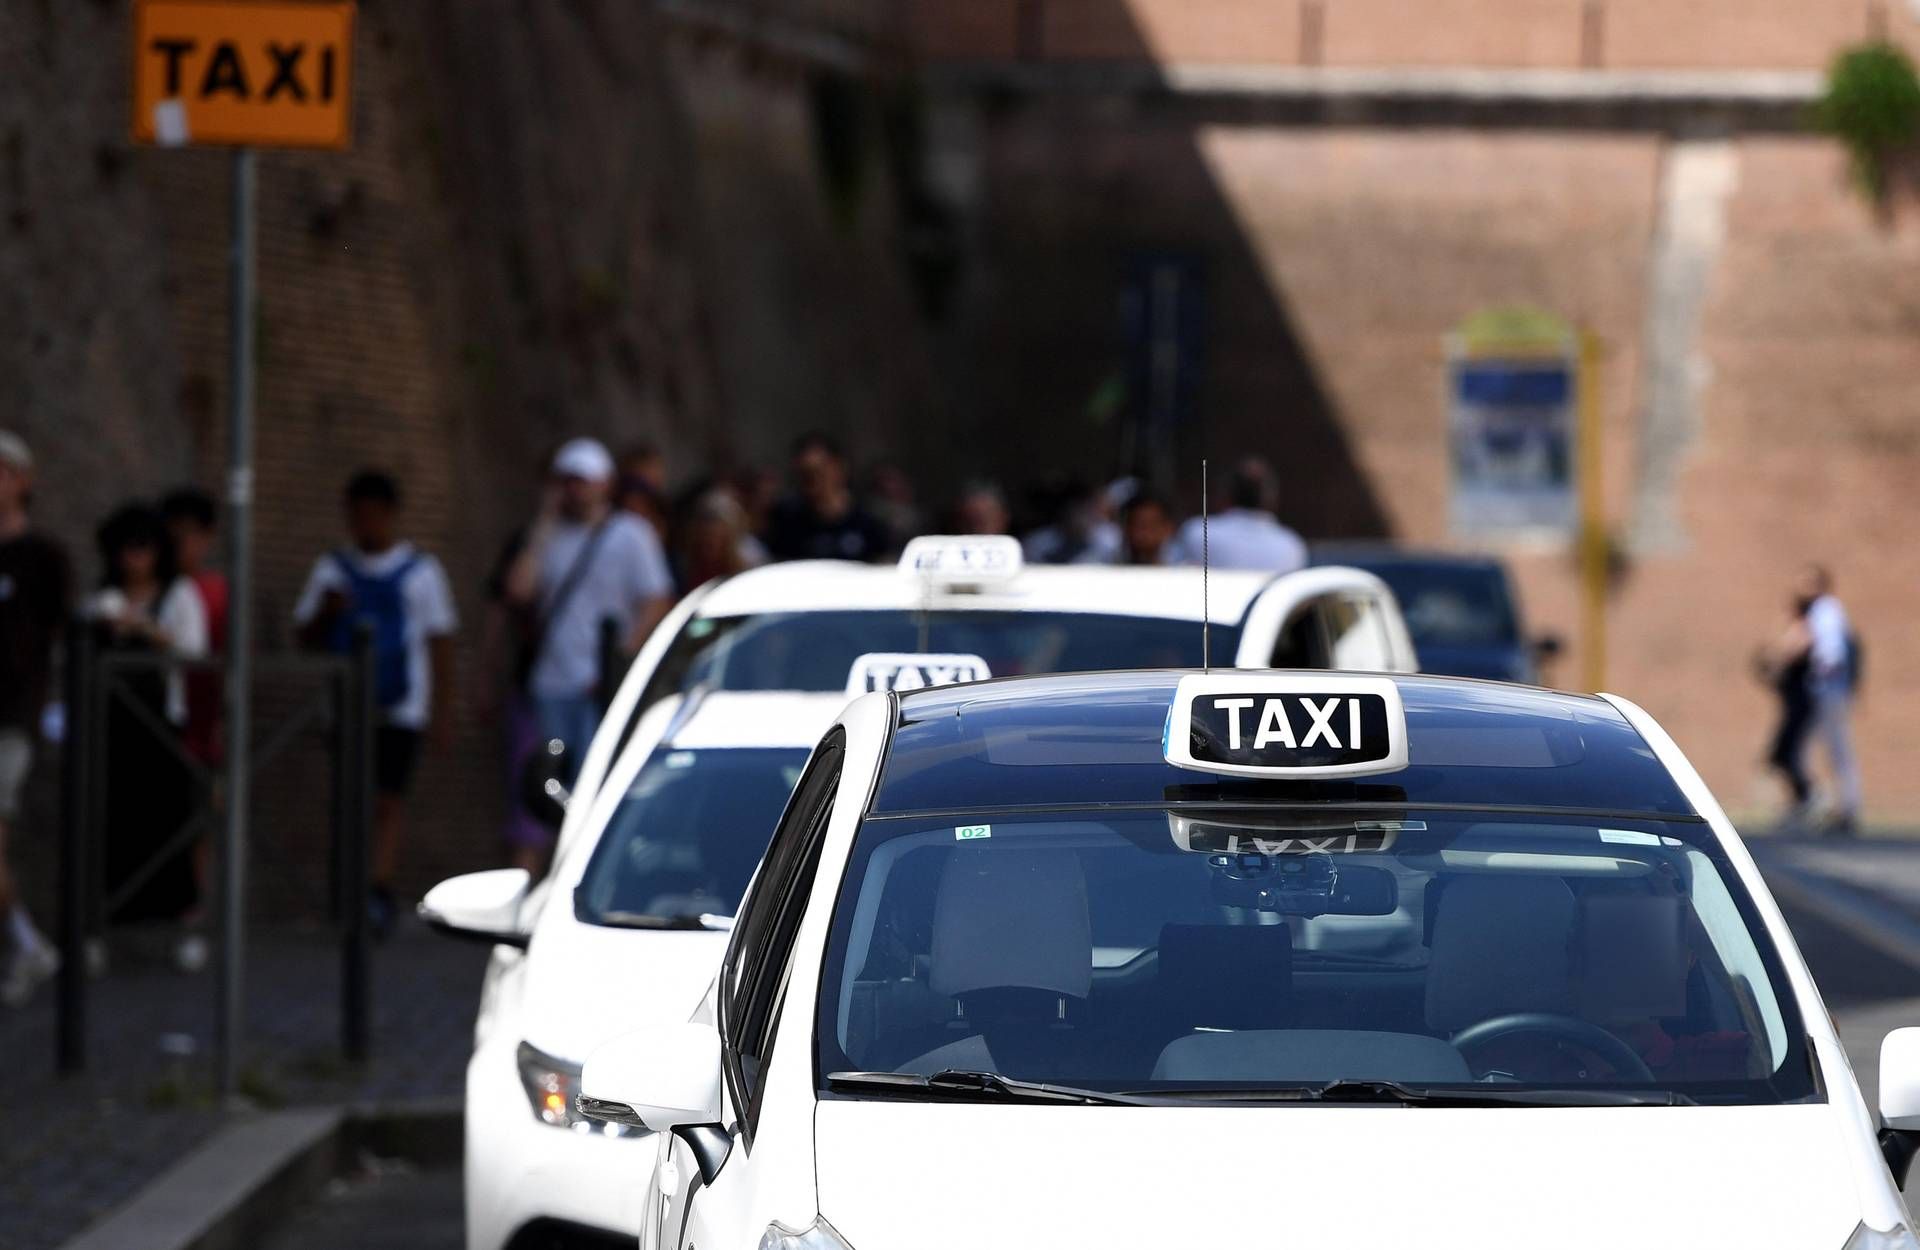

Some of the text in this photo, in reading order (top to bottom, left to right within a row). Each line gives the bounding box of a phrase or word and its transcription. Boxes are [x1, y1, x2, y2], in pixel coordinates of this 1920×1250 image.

[152, 39, 336, 104] TAXI
[1213, 697, 1361, 750] TAXI
[961, 827, 986, 838] 02
